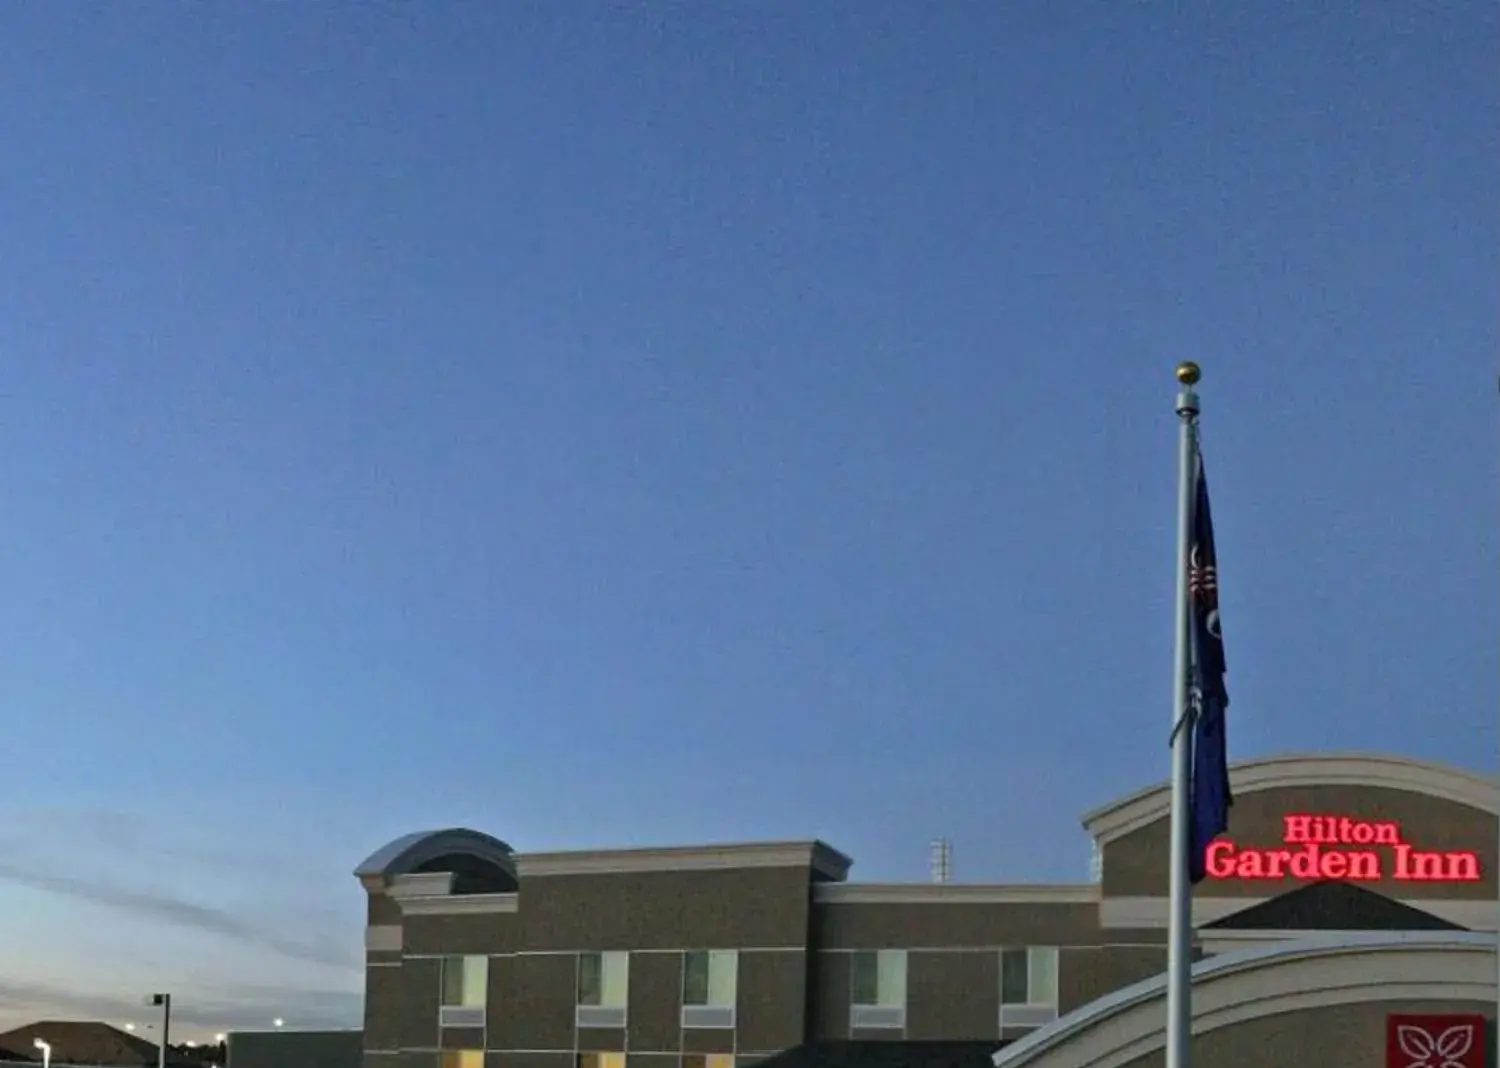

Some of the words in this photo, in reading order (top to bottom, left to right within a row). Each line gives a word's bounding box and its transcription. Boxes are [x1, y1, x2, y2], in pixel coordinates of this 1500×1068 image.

[1283, 815, 1399, 844] Hilton
[1205, 841, 1380, 879] Garden
[1392, 844, 1480, 880] Inn
